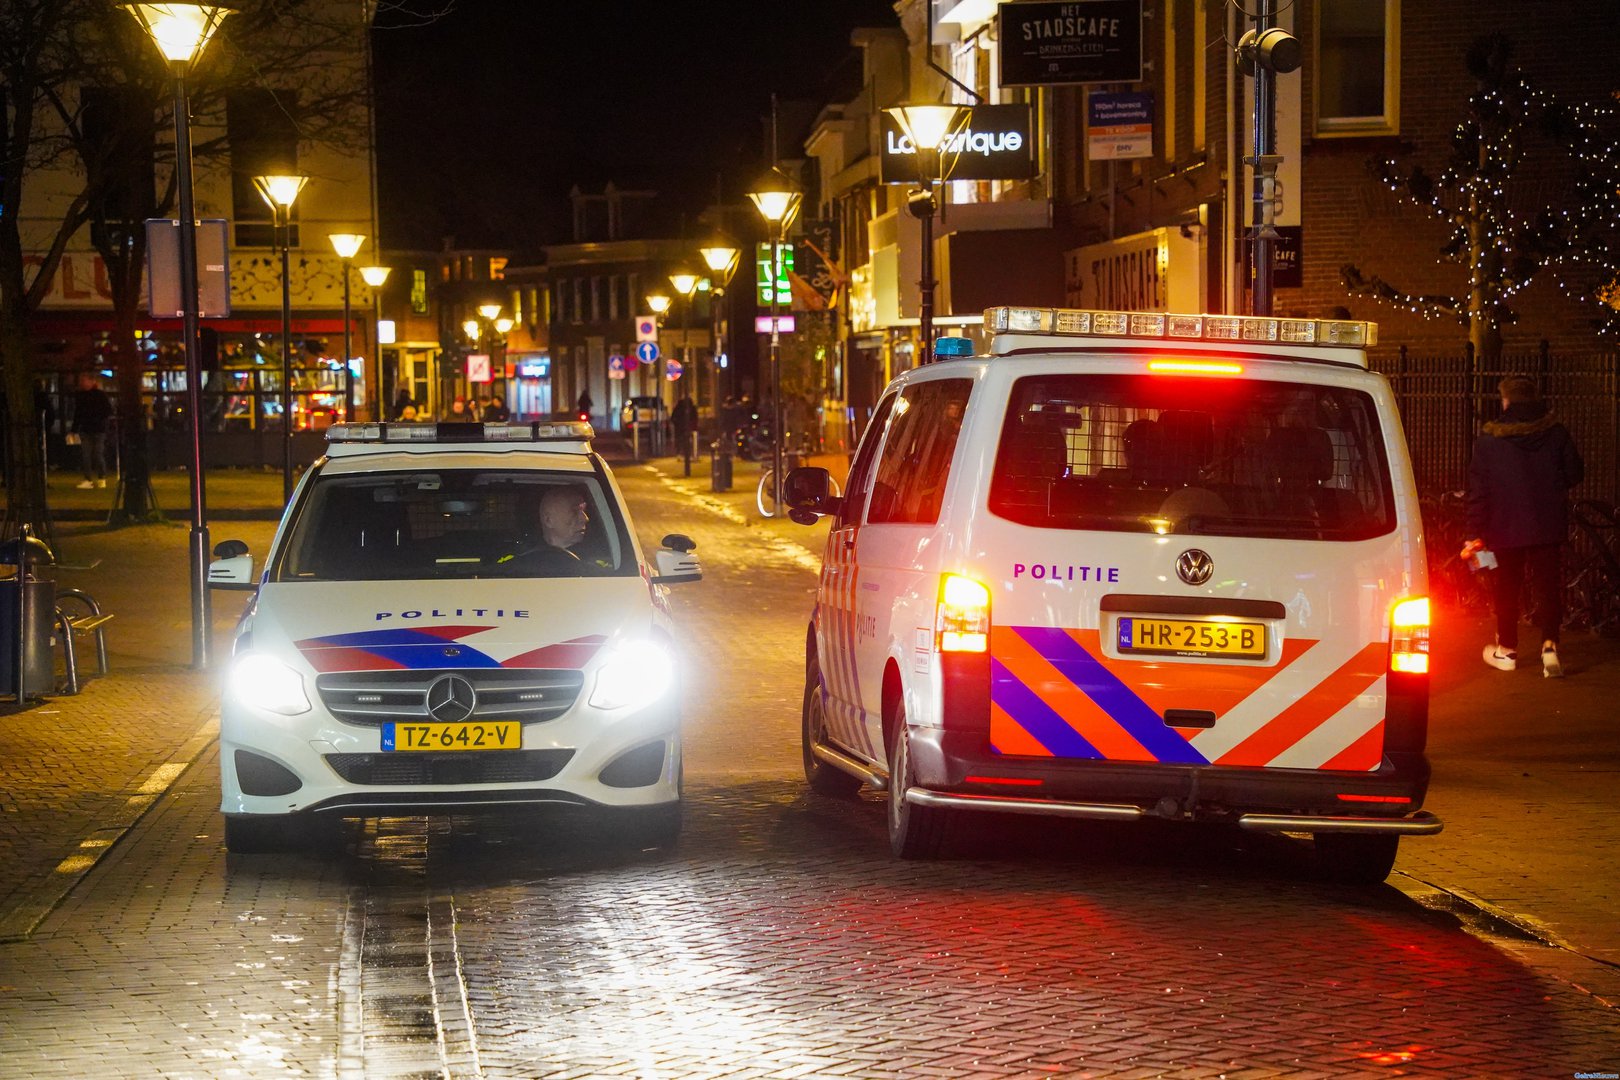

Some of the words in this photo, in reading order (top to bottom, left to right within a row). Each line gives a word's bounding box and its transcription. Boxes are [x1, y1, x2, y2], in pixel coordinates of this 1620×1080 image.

[1061, 5, 1080, 17] HET
[1022, 17, 1120, 40] STADSCAFE
[1014, 563, 1119, 583] POLITIE
[376, 609, 530, 621] POLITIE
[1121, 636, 1131, 644] NL
[1140, 623, 1255, 649] HR-253-B
[384, 738, 394, 746] NL
[403, 725, 509, 747] TZ-642-V
